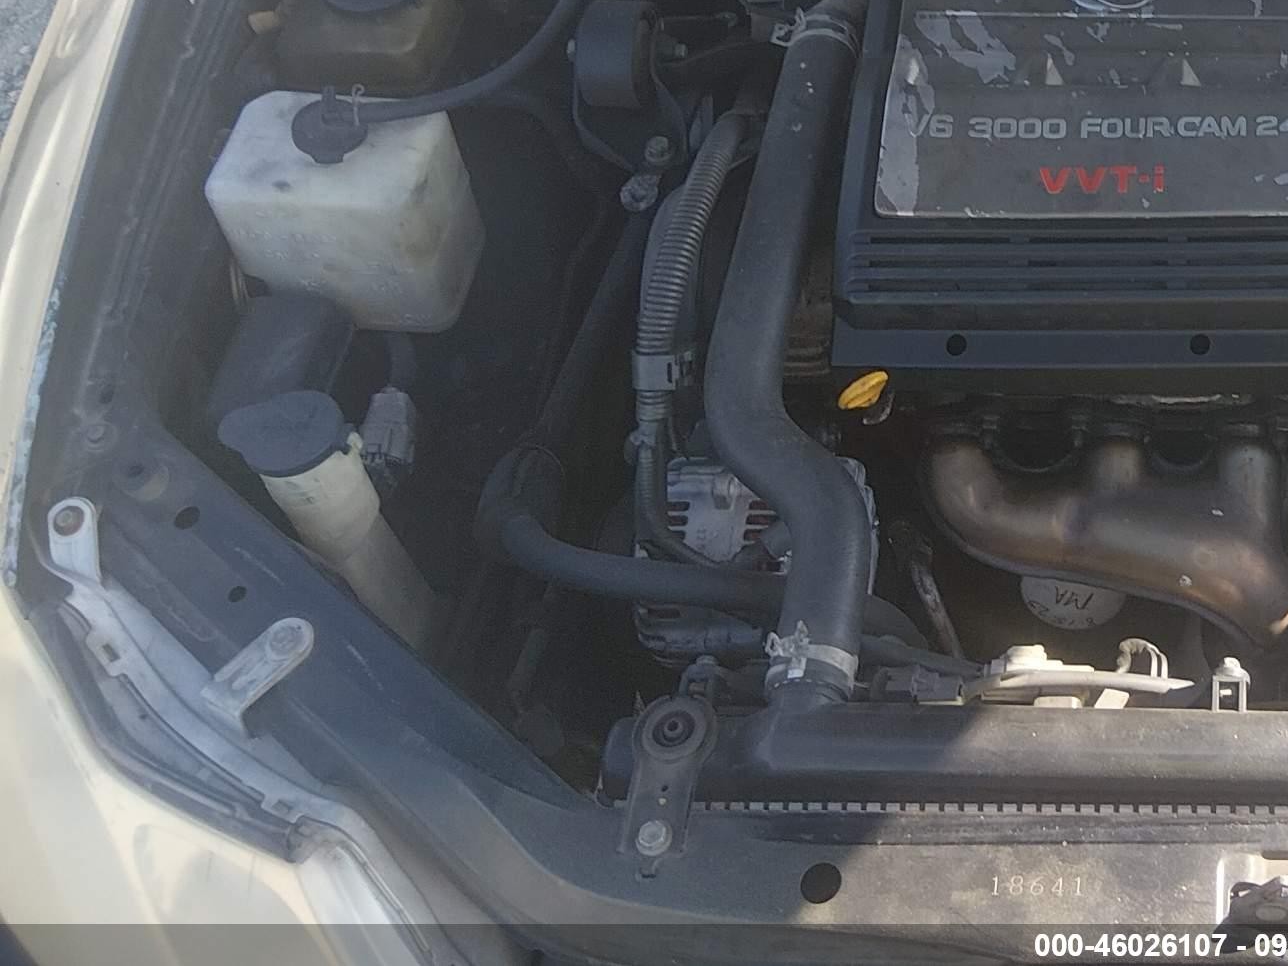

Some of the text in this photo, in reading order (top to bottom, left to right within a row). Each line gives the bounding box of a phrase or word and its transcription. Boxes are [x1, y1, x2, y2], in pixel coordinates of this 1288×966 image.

[904, 112, 954, 139] V6
[967, 116, 1067, 139] 3000
[991, 874, 1084, 896] 18641
